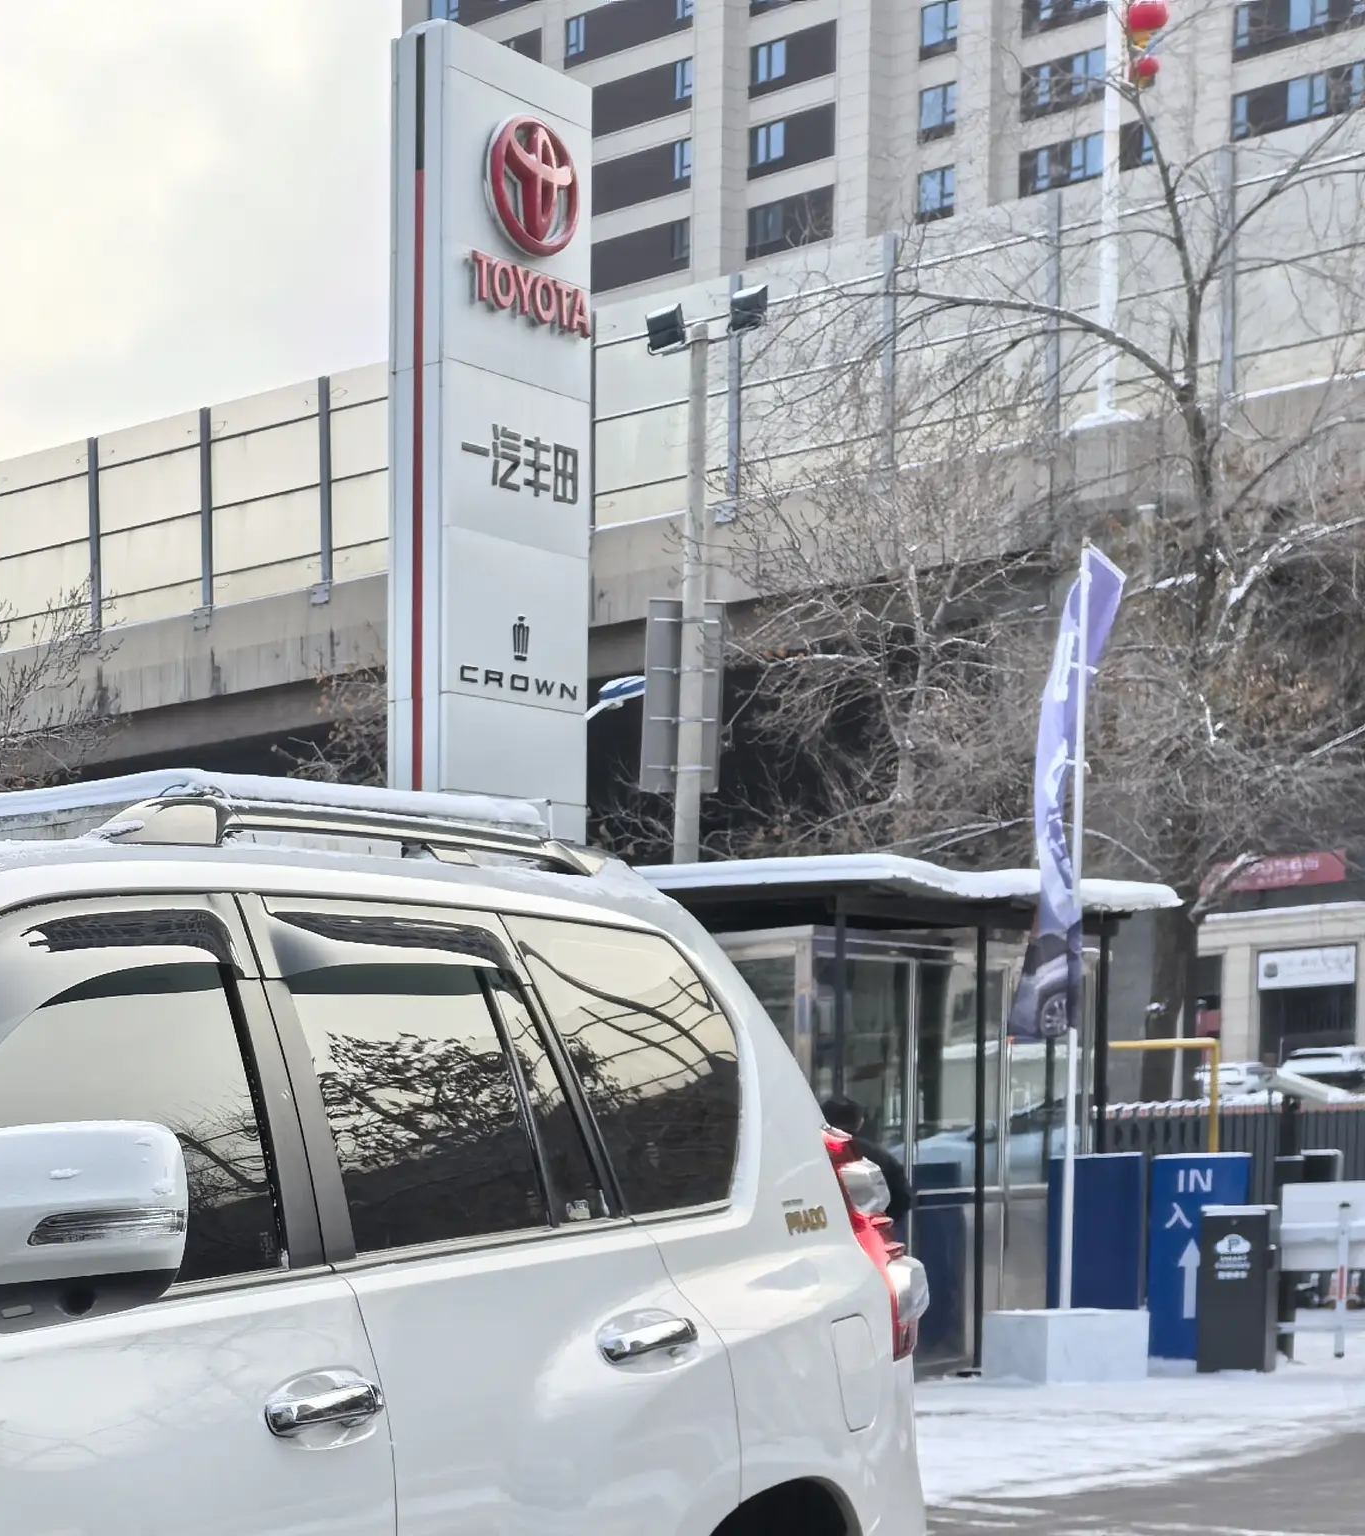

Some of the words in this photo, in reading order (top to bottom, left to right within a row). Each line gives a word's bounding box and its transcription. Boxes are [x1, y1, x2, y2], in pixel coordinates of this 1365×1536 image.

[471, 250, 591, 339] TOYOTA
[461, 423, 578, 504] 一汽丰田
[460, 664, 577, 701] CROWN
[1177, 1168, 1213, 1193] IN
[1165, 1202, 1193, 1229] 入
